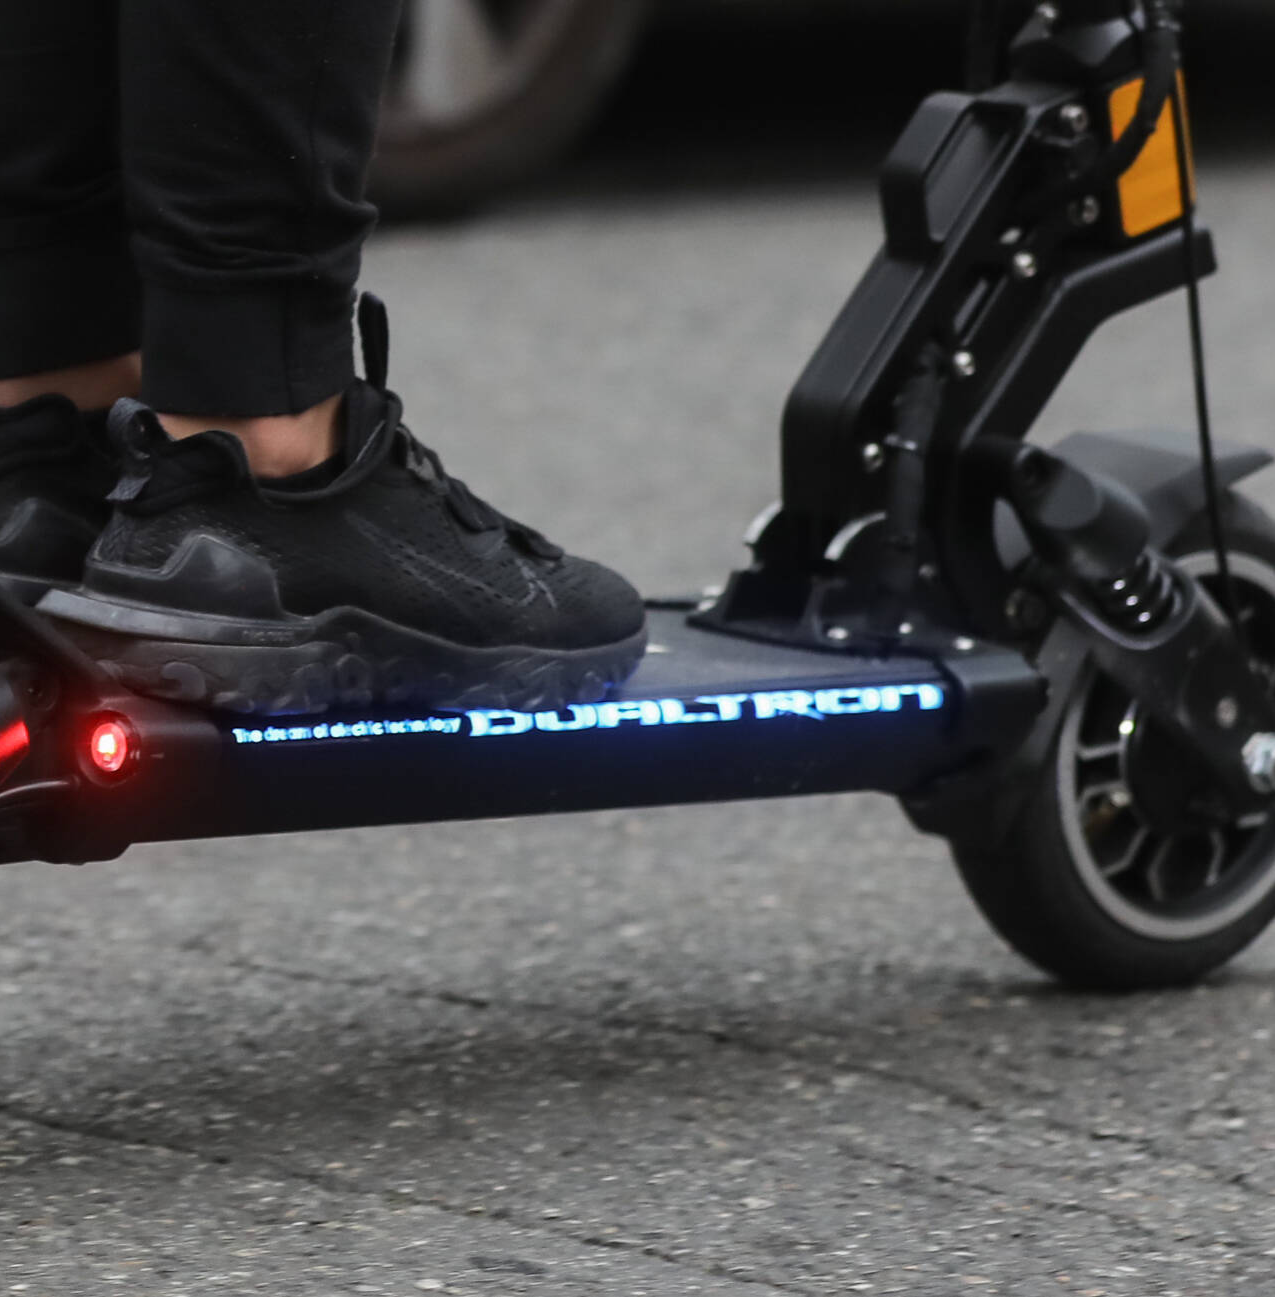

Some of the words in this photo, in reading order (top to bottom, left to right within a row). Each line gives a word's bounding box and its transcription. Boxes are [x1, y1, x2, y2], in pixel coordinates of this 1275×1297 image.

[232, 726, 263, 744] The
[264, 724, 313, 742] dream
[313, 722, 329, 739] of
[329, 720, 384, 739] electric
[384, 716, 462, 735] technology
[464, 683, 944, 737] DUALTRON
